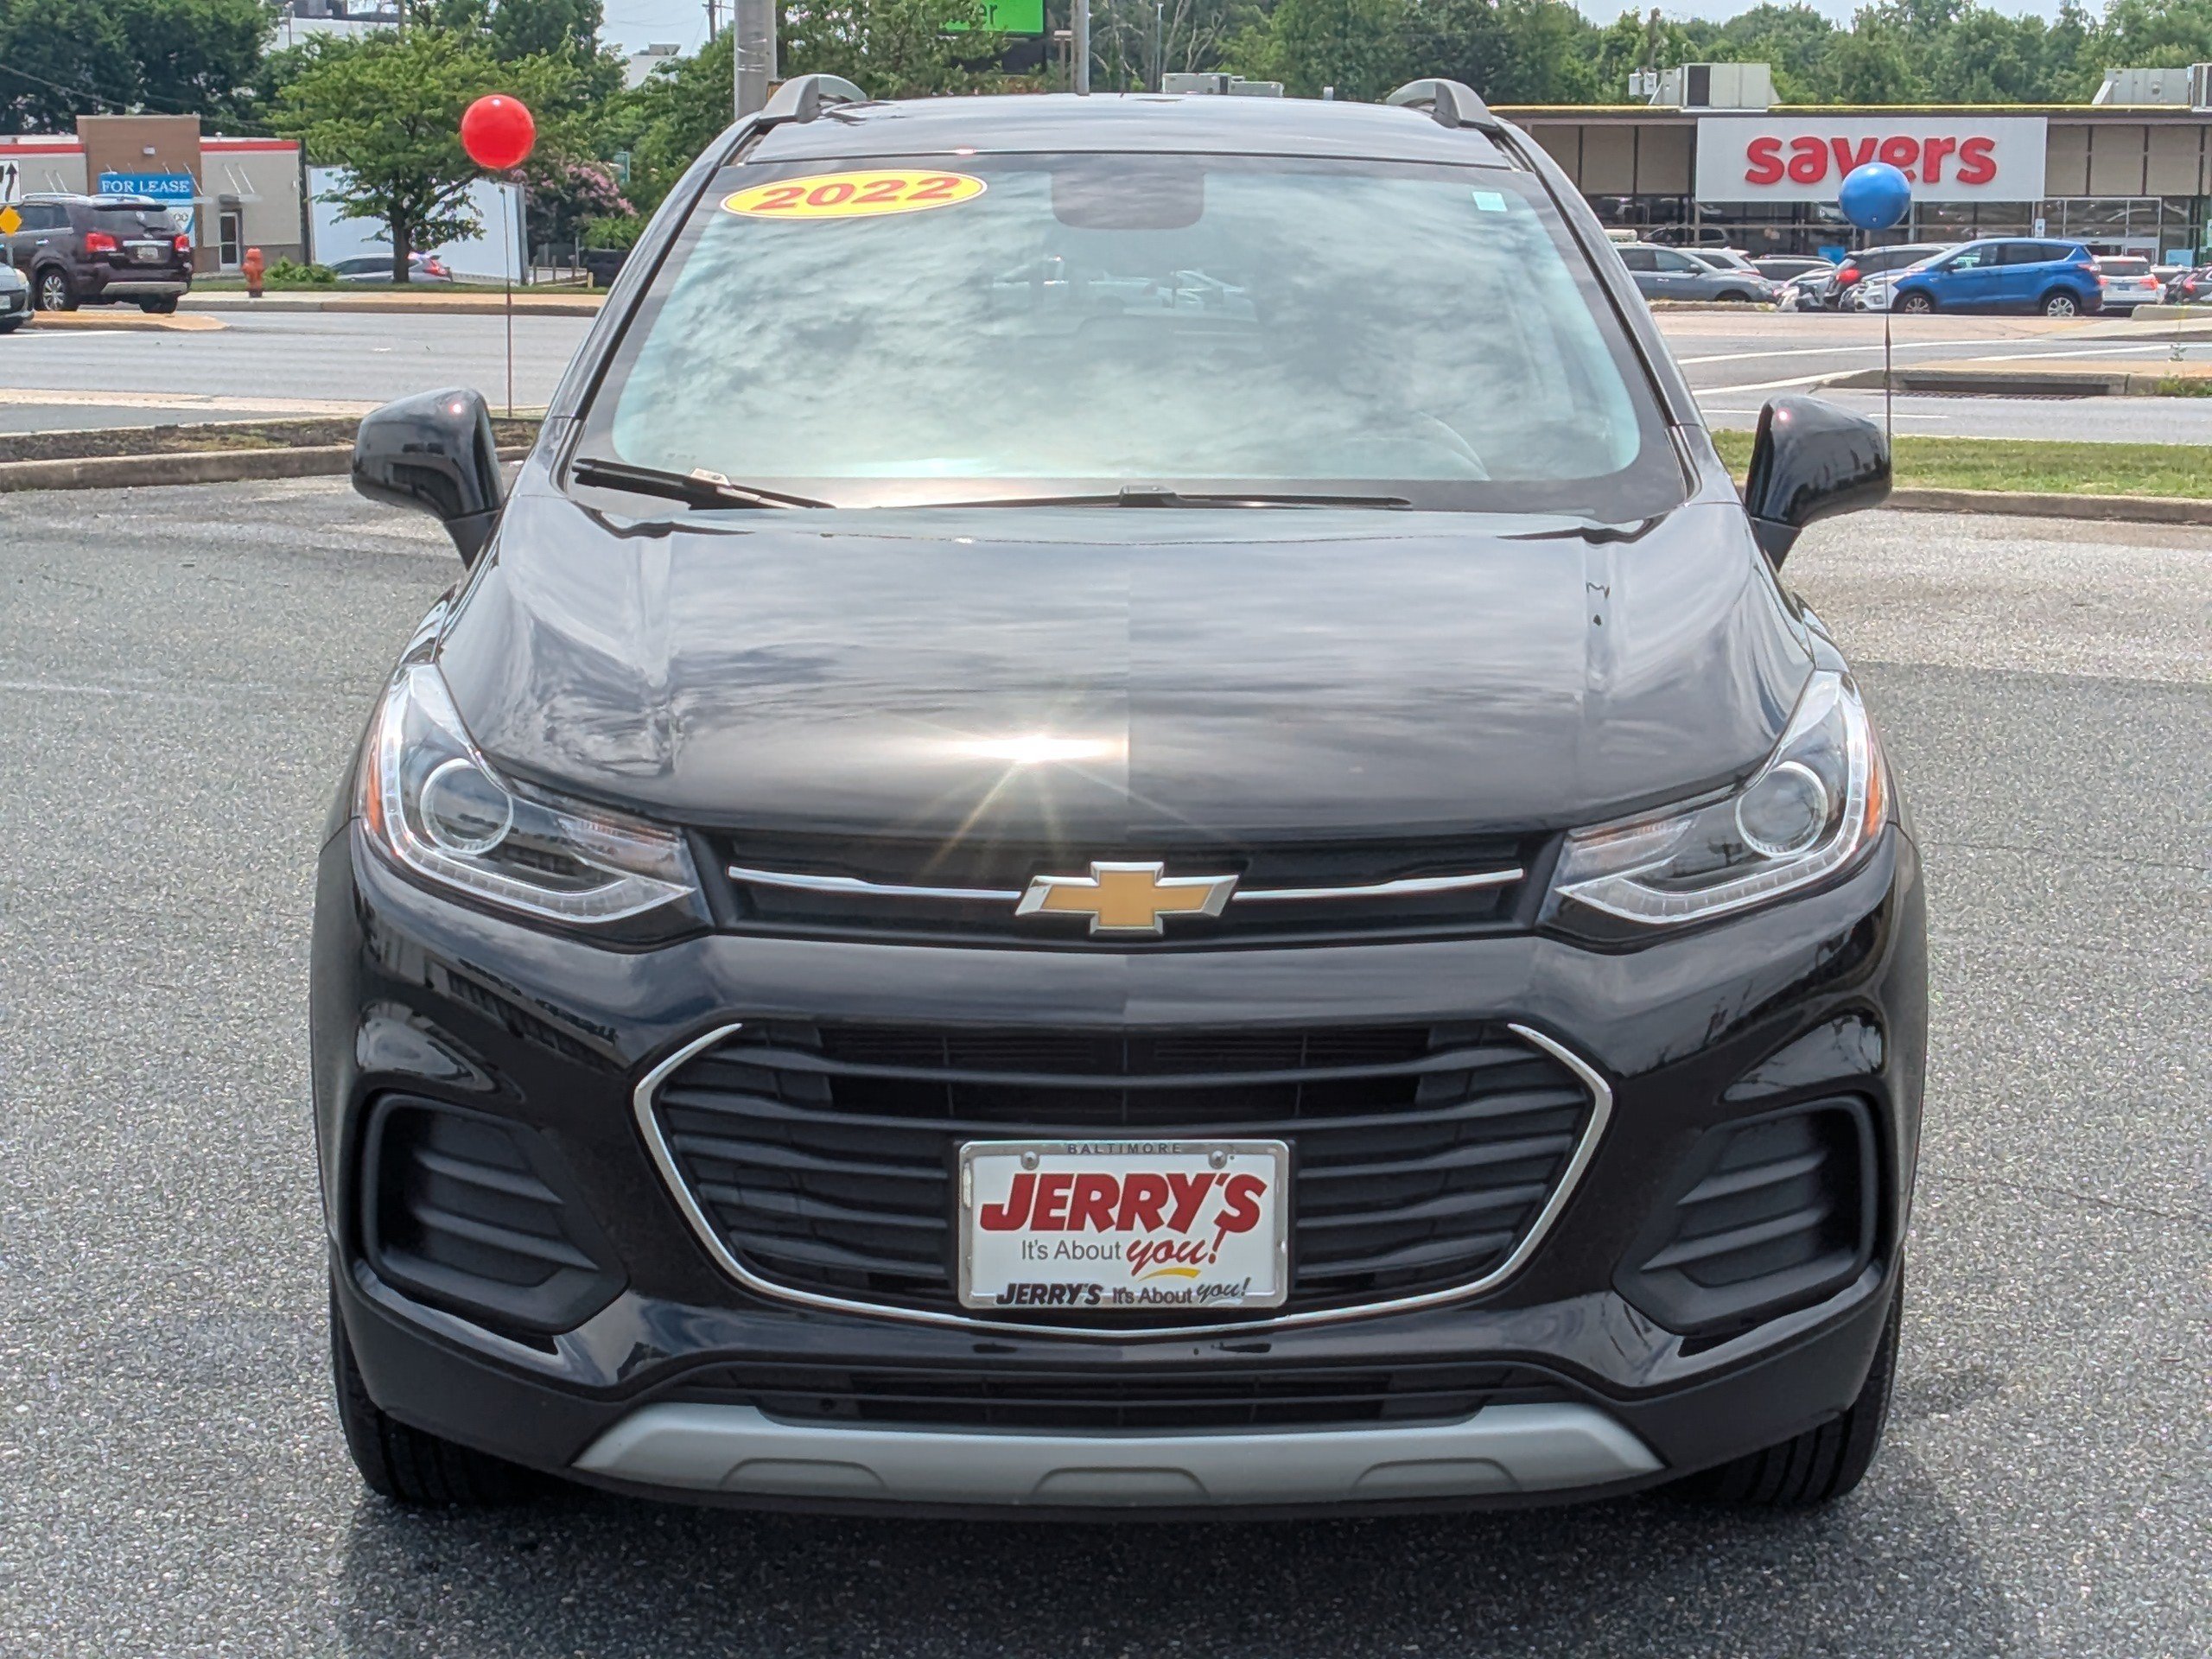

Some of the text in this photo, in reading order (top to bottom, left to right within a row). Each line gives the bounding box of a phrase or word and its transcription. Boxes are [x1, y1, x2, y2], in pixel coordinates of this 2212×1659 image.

[1745, 136, 1997, 185] savers
[101, 181, 190, 193] FOR LEASE
[751, 177, 961, 210] 2022
[1067, 1142, 1181, 1154] BALTIMORE
[980, 1173, 1268, 1233] JERRY'S
[1021, 1228, 1227, 1276] It's About you!
[996, 1277, 1251, 1306] JERRY'S It's About you!
